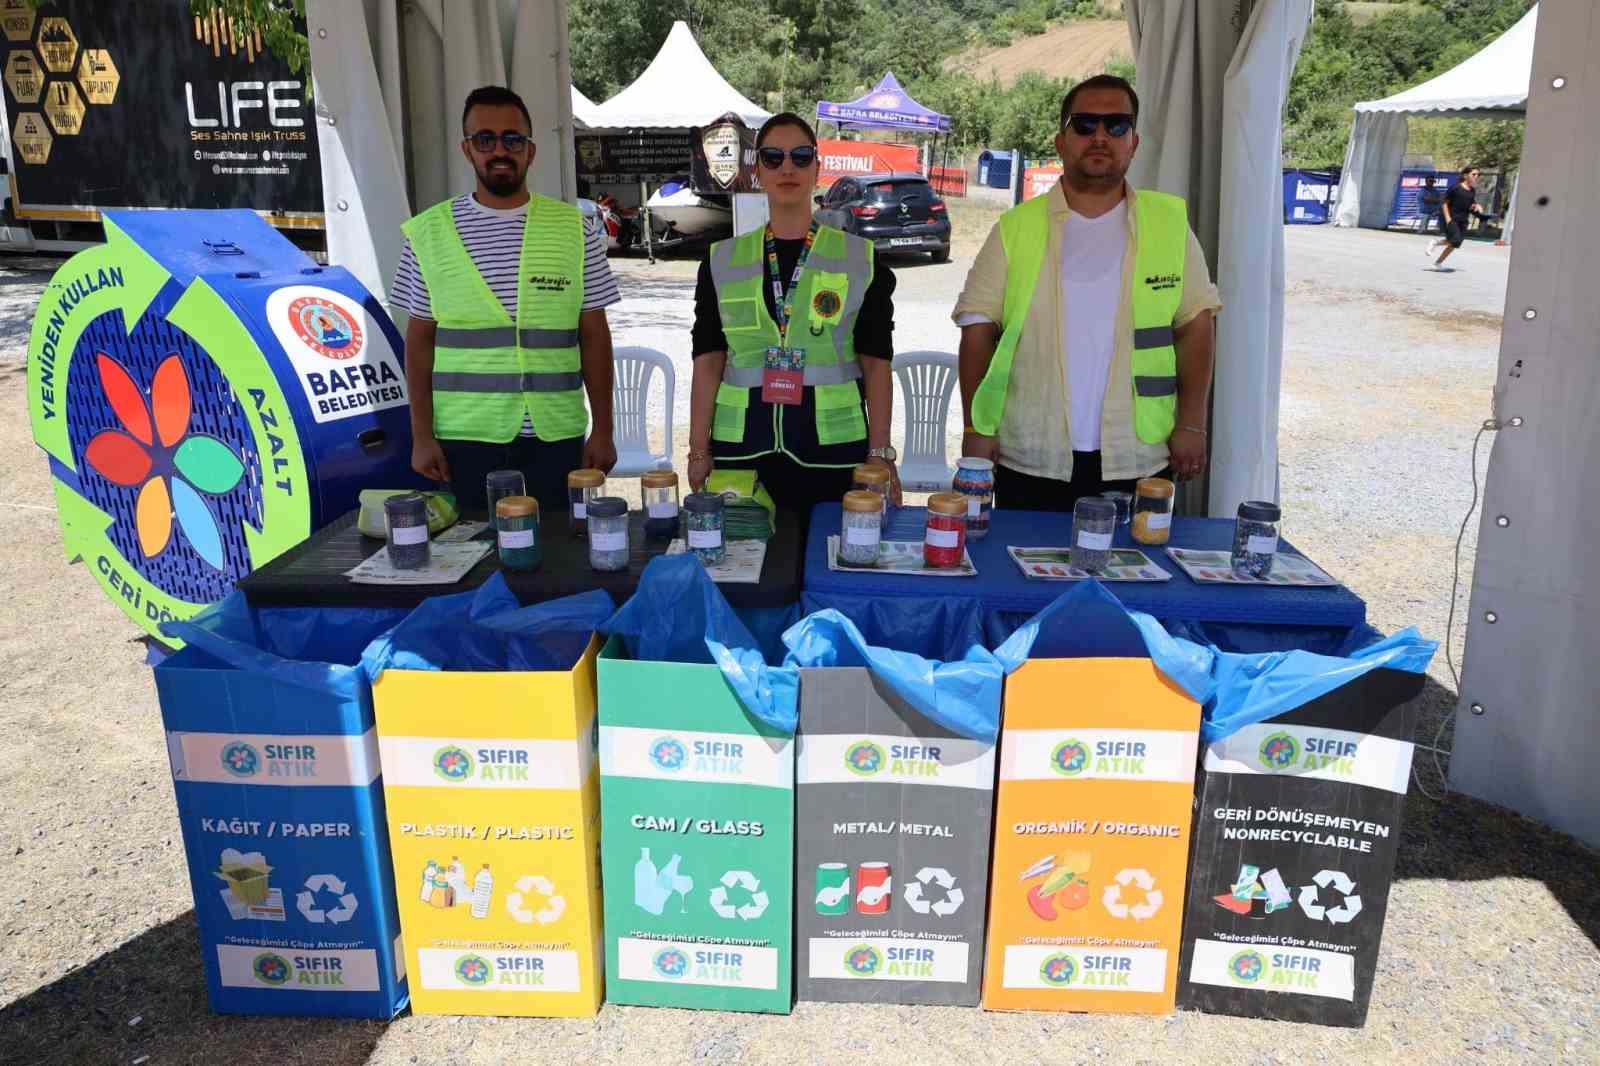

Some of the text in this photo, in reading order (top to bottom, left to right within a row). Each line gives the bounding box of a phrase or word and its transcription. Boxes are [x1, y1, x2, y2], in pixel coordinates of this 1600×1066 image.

[185, 81, 304, 127] LIFE
[191, 130, 211, 141] Ses
[214, 130, 249, 141] Sahne
[273, 131, 306, 141] Truss
[824, 154, 873, 171] FESTİVALİ
[37, 266, 125, 419] YENİDEN KULLAN
[306, 361, 399, 396] BAFRA
[248, 389, 292, 496] AZALT
[97, 555, 143, 609] GERİ
[264, 744, 316, 760] SIFIR
[694, 741, 743, 758] SIFIR
[891, 744, 941, 760] SIFIR
[1096, 741, 1146, 757] SIFIR
[1305, 737, 1358, 757] SIFIR
[478, 749, 529, 764] SIFIR
[268, 761, 316, 777] ATIK
[480, 765, 529, 781] ATIK
[891, 760, 939, 776] ATIK
[1096, 757, 1145, 774] ATIK
[1304, 755, 1354, 775] ATIK
[202, 818, 351, 838] KAĞIT / PAPER
[631, 814, 764, 836] CAM / GLASS
[1013, 819, 1088, 835] ORGANİK
[1104, 823, 1181, 839] ORGANIC
[1214, 806, 1390, 838] GERİ DÖNÜŞEMEYEN
[496, 826, 576, 841] PLASTIC
[900, 823, 954, 838] METAL
[1223, 827, 1372, 853] NONRECYCLABLE
[696, 951, 743, 966] SIFIR
[888, 947, 934, 961] SIFIR
[295, 956, 343, 970] SIFIR
[497, 956, 544, 971] SIFIR
[888, 961, 933, 976] ATIK
[1084, 956, 1132, 971] SIFIR
[1271, 953, 1321, 972] SIFIR
[298, 970, 344, 985] ATIK
[500, 971, 544, 985] ATIK
[1084, 970, 1130, 986] ATIK
[1271, 970, 1319, 988] ATIK
